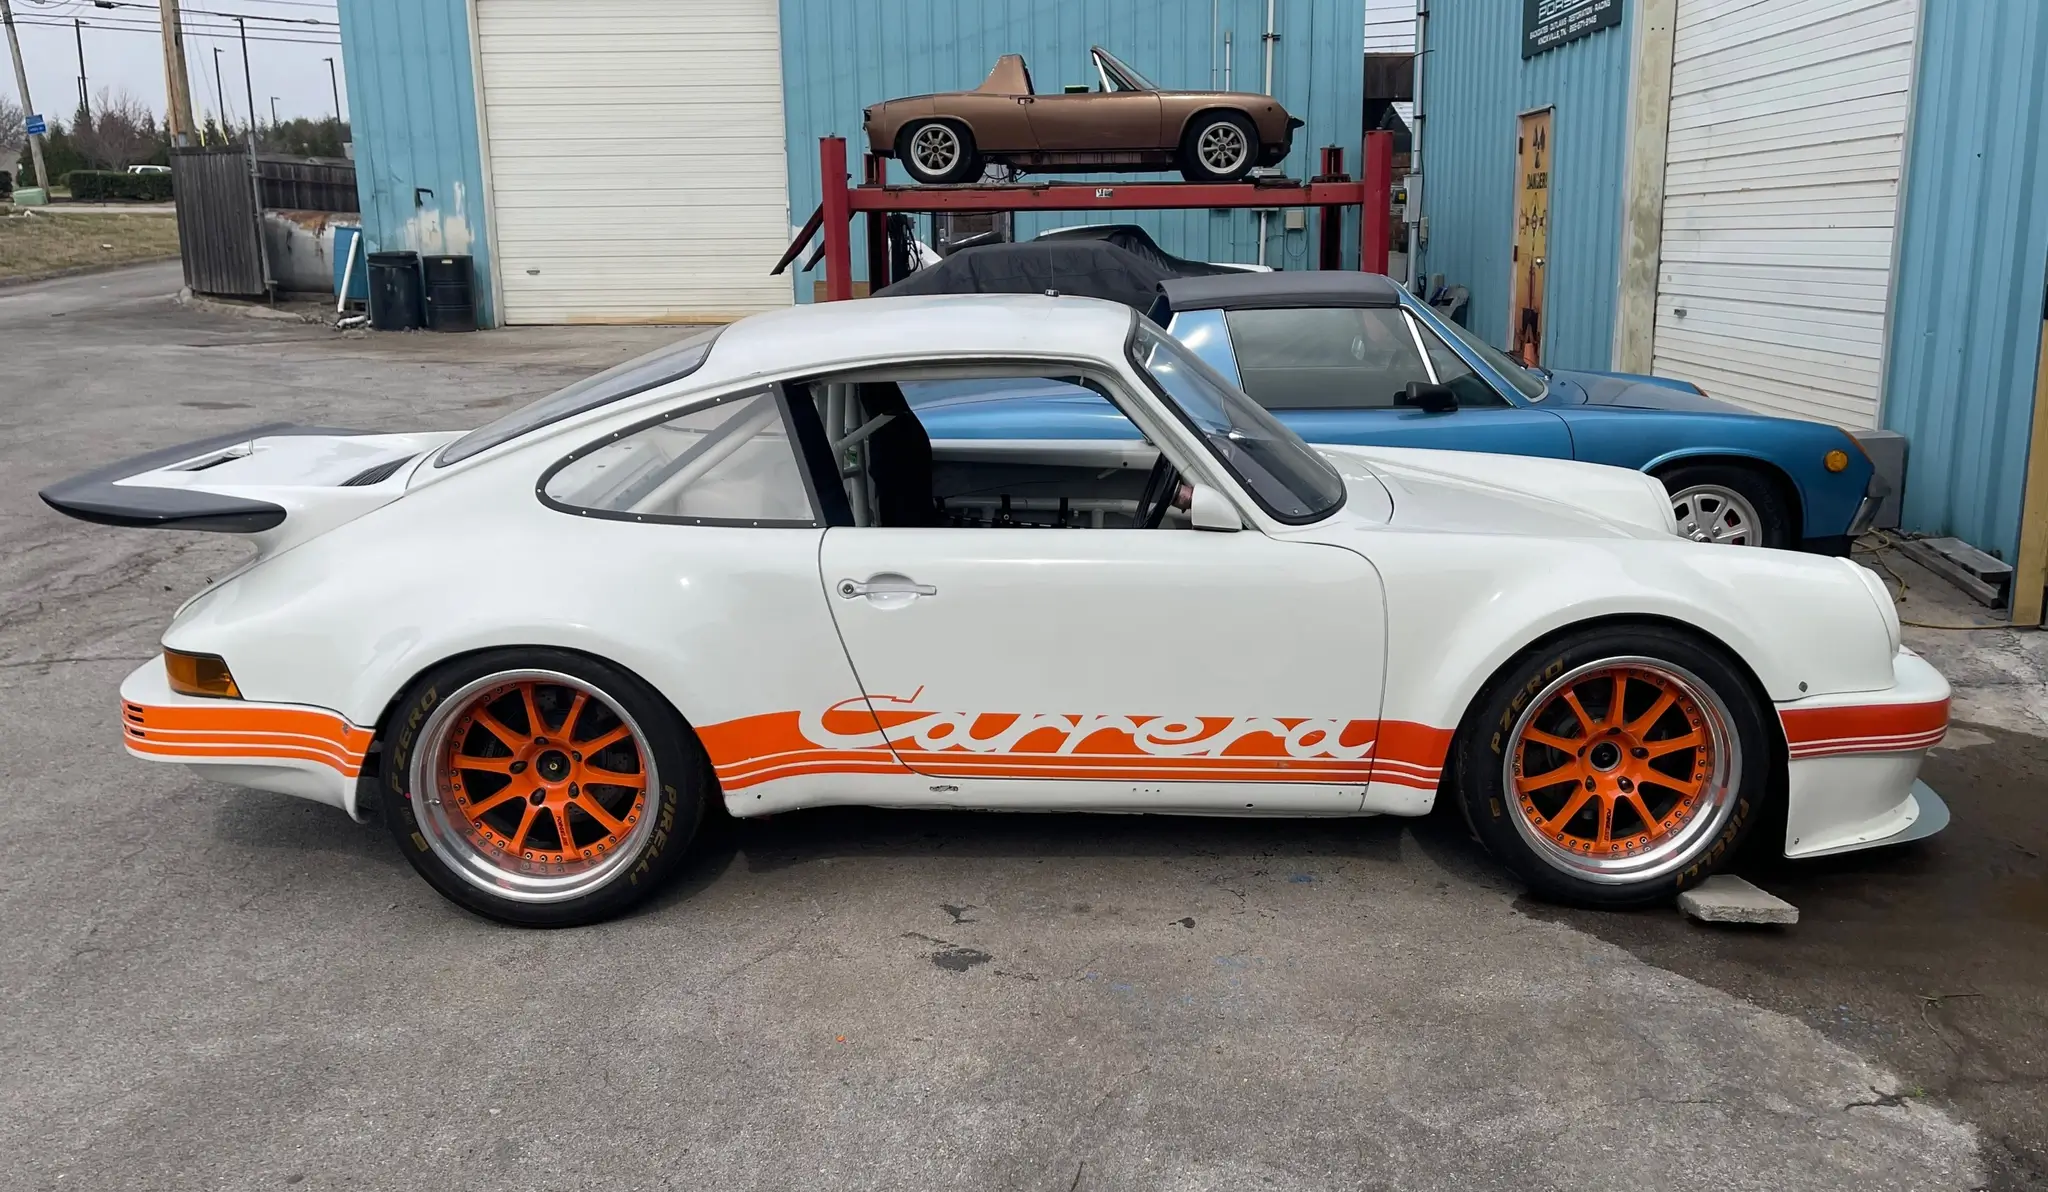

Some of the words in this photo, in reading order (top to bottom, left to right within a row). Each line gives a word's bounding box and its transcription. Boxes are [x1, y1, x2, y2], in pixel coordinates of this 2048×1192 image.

[393, 685, 437, 770] ZERO
[798, 685, 1376, 760] Carrera
[1490, 731, 1501, 755] P
[1500, 658, 1564, 731] ZERO
[391, 772, 404, 796] P
[630, 784, 677, 886] PIRELLI
[1676, 798, 1750, 886] PIRELLI
